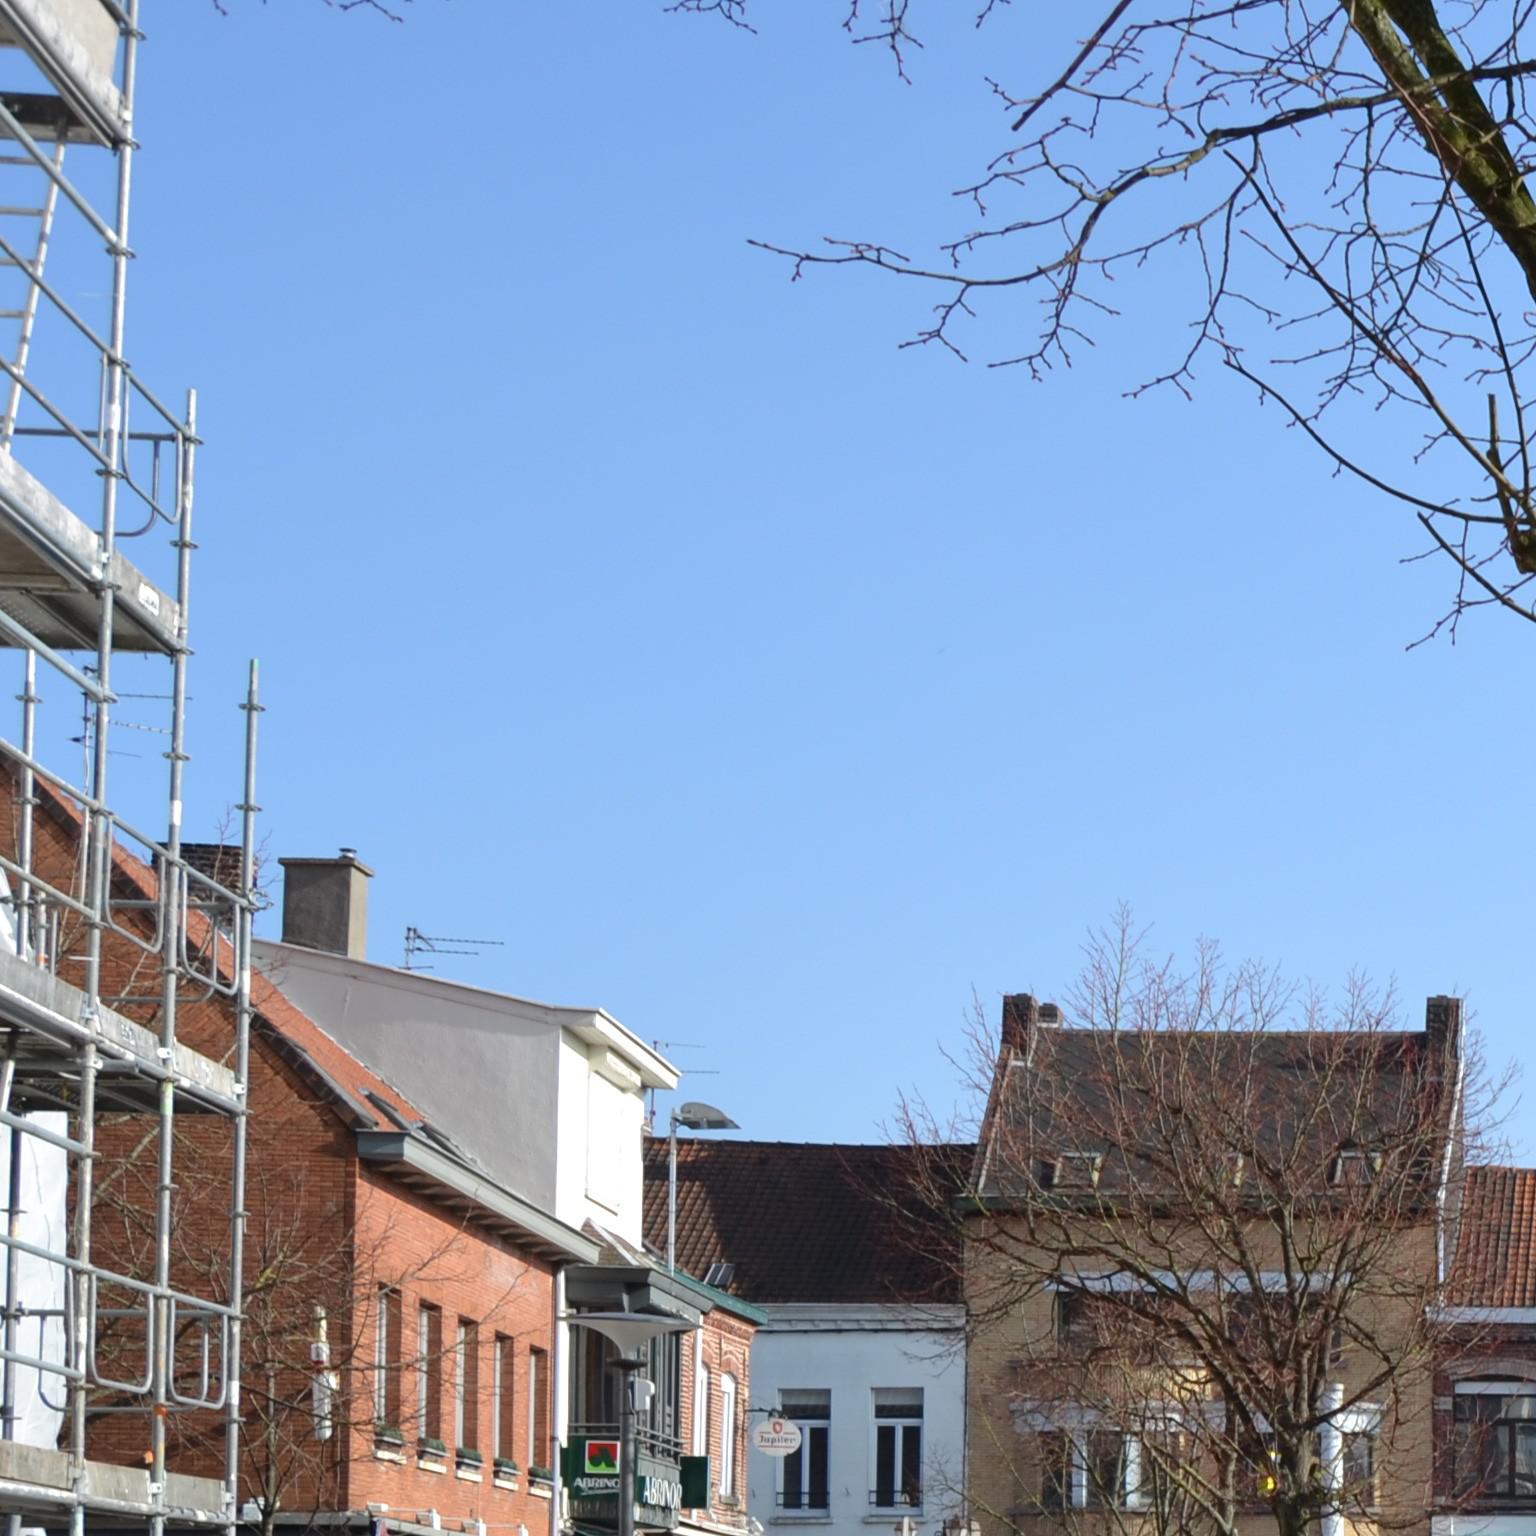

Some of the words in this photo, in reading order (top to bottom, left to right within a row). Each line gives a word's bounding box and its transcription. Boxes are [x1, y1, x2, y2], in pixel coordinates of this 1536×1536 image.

[758, 1434, 796, 1445] Jupiler
[573, 1477, 620, 1490] ABRINO
[642, 1476, 683, 1510] ABRINOR
